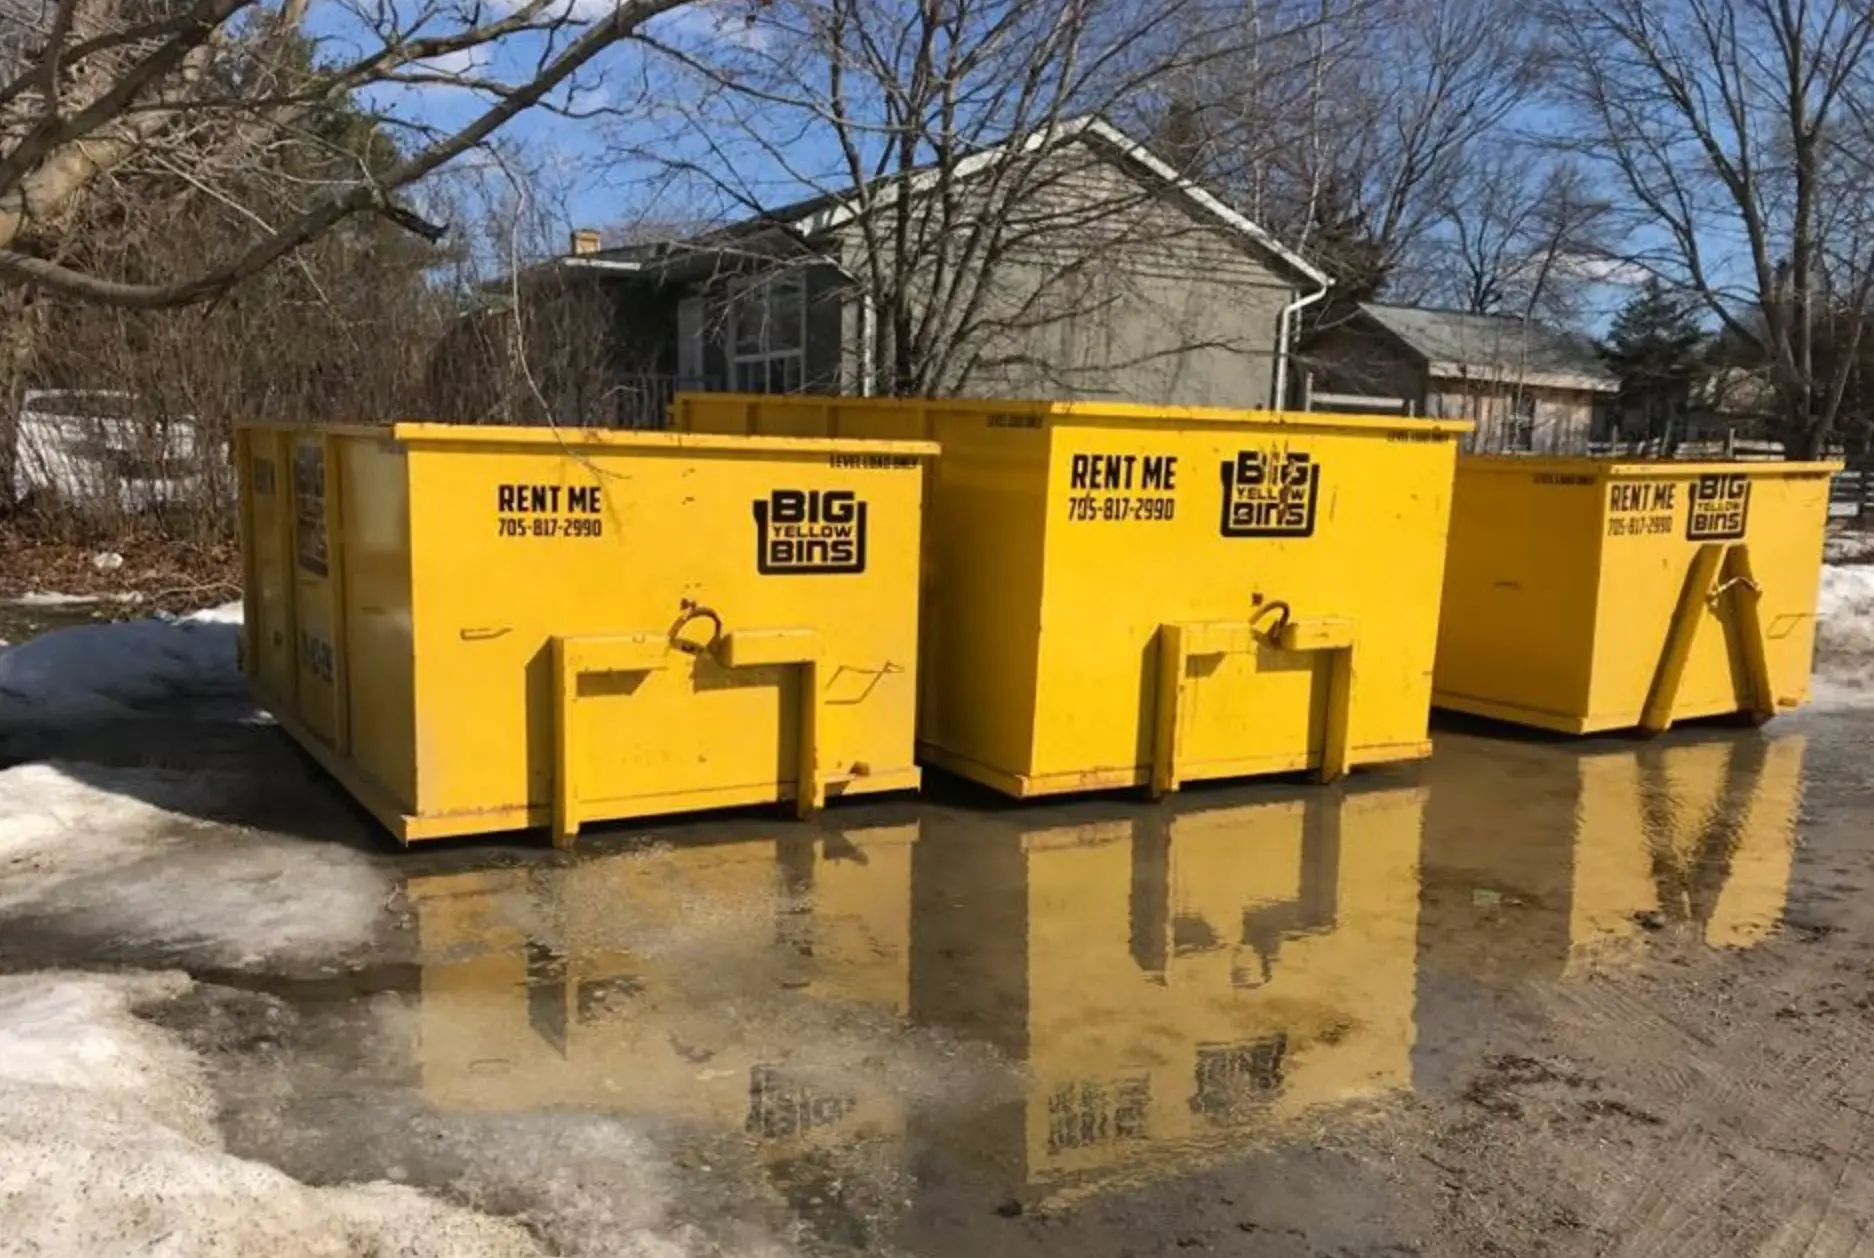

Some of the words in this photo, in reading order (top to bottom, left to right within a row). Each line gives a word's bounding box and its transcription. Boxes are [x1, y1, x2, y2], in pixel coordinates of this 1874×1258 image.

[1071, 454, 1137, 489] RENT
[1142, 456, 1178, 489] ME
[1237, 450, 1310, 485] BIG
[498, 484, 562, 512] RENT
[567, 486, 601, 512] ME
[1237, 487, 1305, 501] YELLW
[1610, 484, 1652, 511] RENT
[1651, 483, 1676, 511] ME
[1698, 474, 1747, 499] BIG
[772, 490, 855, 523] BIG
[1068, 497, 1175, 520] 705-817-2990
[498, 518, 602, 537] 705-817-2990
[773, 525, 852, 538] YELLOW
